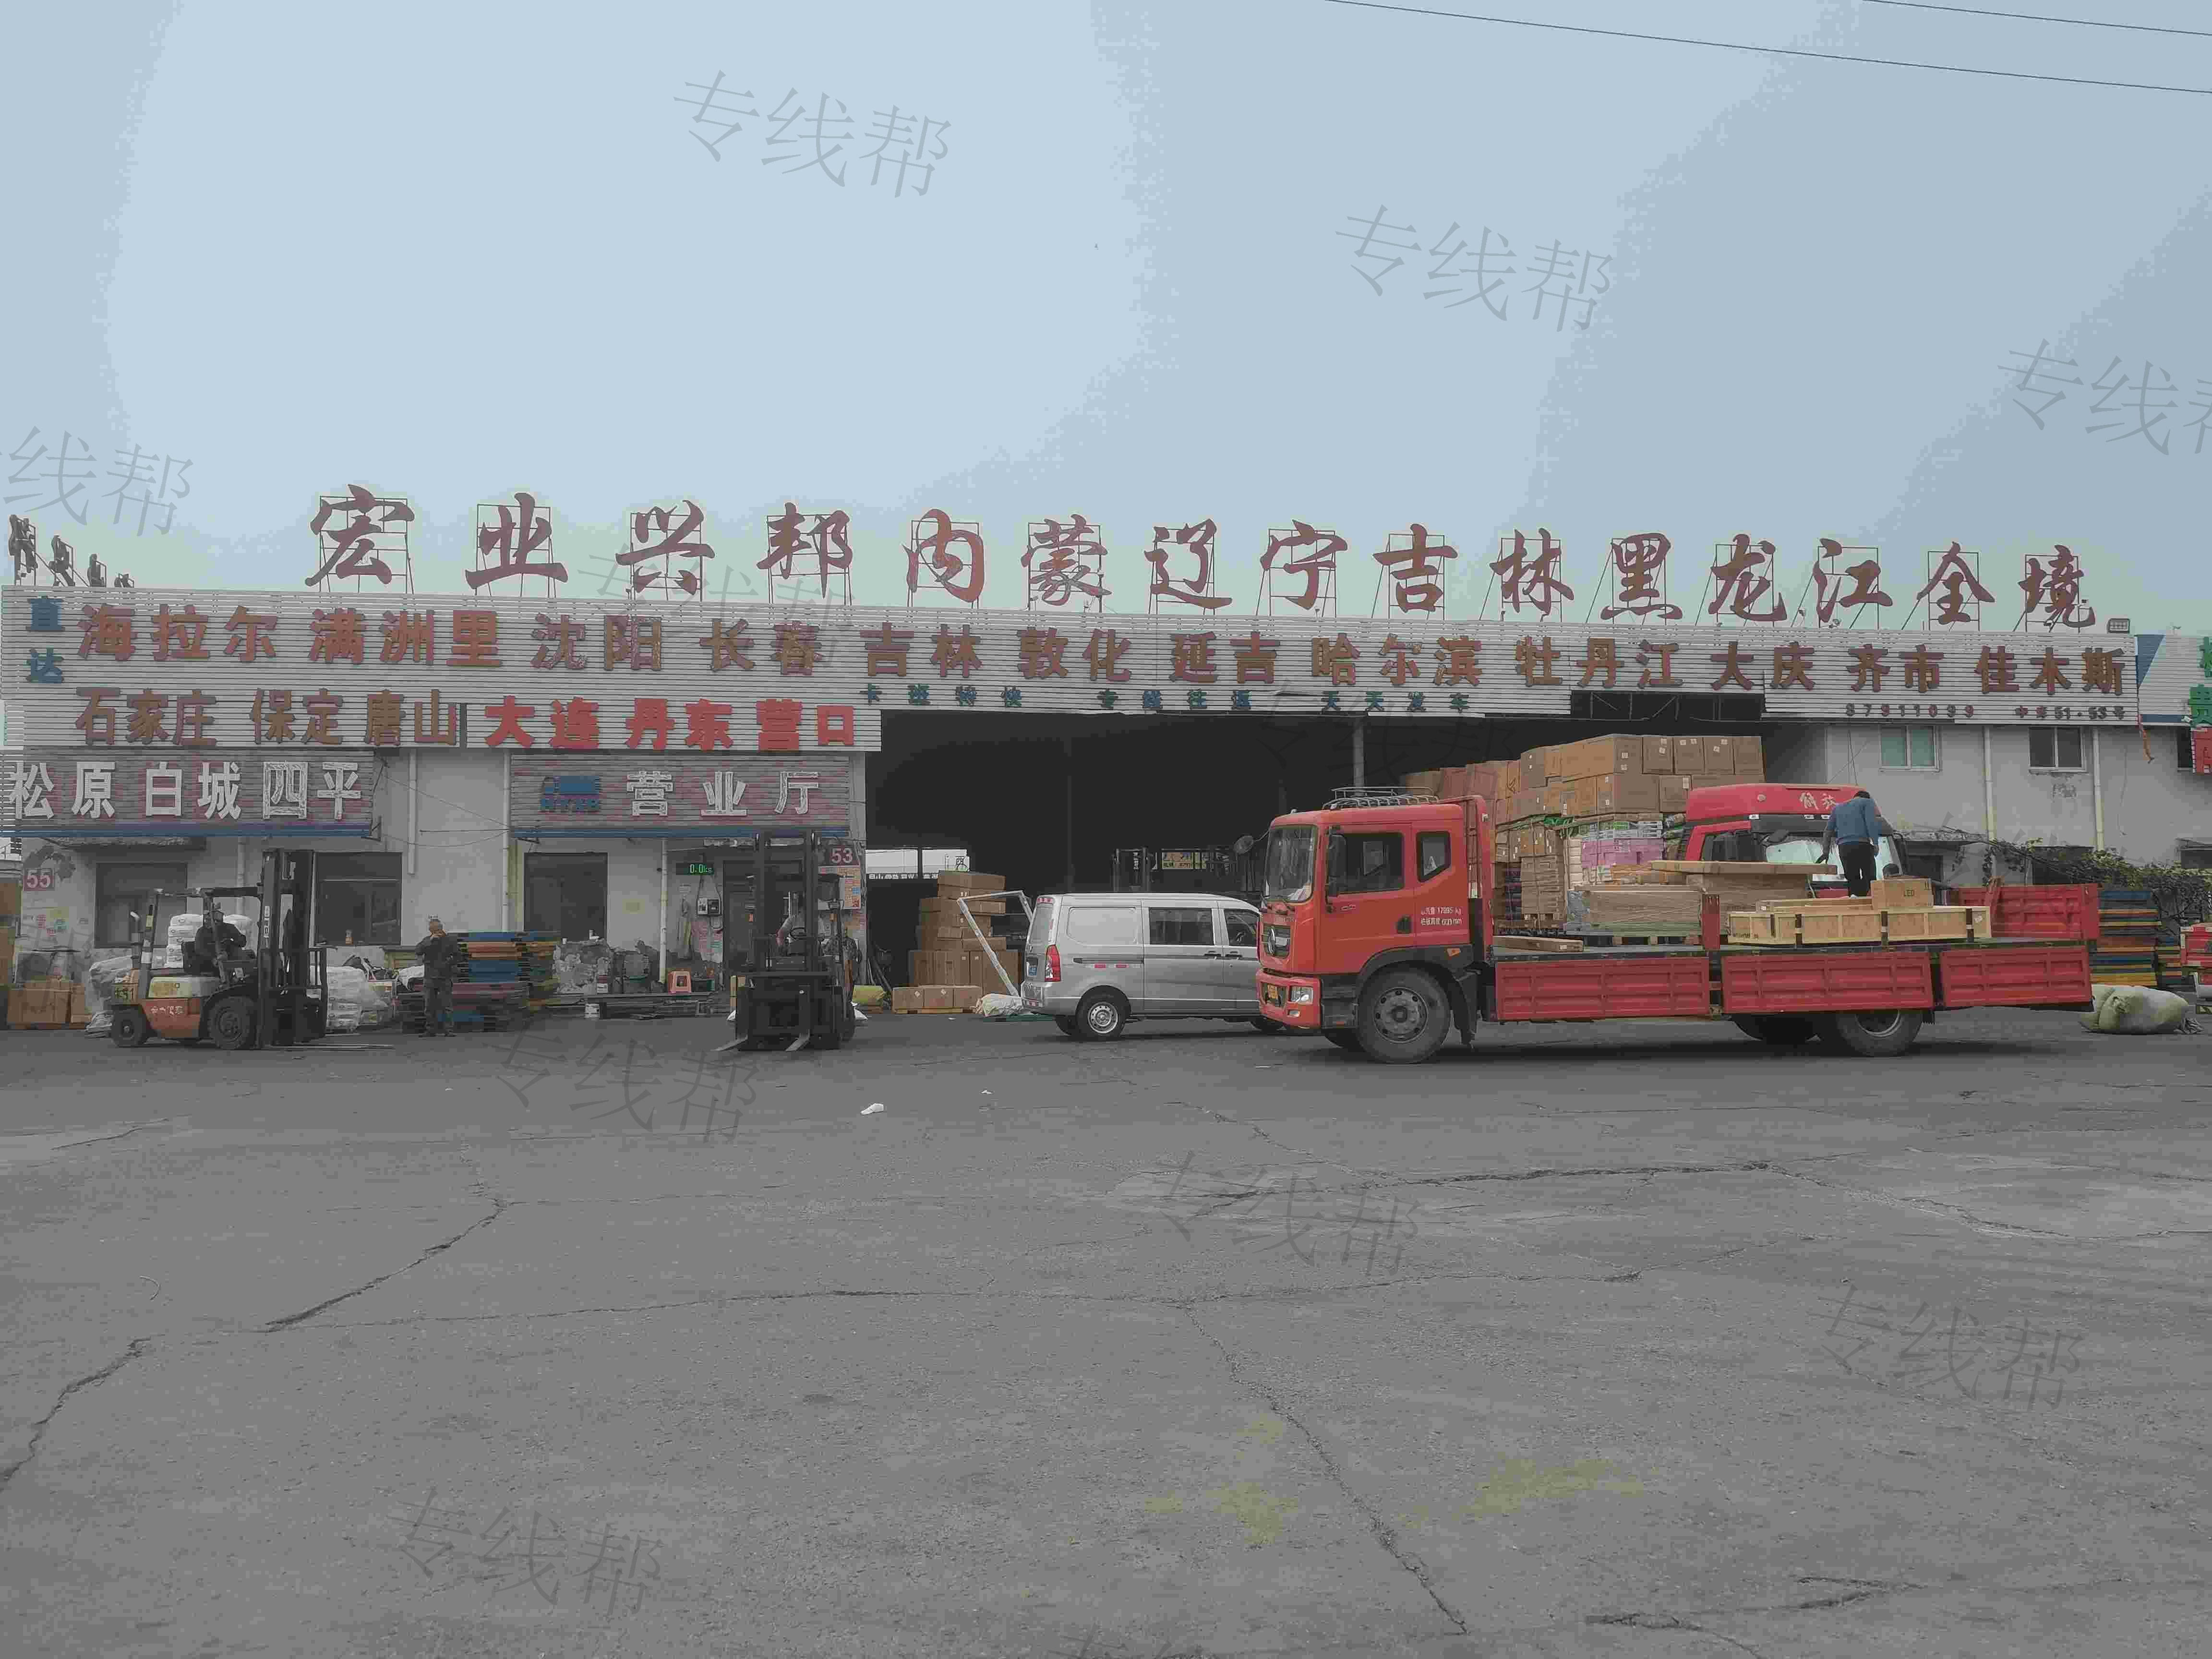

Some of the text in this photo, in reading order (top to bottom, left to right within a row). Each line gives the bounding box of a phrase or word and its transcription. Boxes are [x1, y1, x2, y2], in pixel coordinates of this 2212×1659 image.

[26, 596, 64, 684] 直达
[77, 604, 2125, 696] 海拉尔 满洲里 沈阳 长春 吉林 敦化 延吉 哈尔滨 牡丹江 大庆 齐市 佳木斯
[75, 686, 457, 746] 石家庄 保定 唐山
[484, 695, 855, 752] 大连 丹东 营口
[1320, 690, 1470, 714] 天天发车
[8, 760, 362, 820] 松原 白城 四平
[626, 770, 820, 817] 营业厅
[27, 869, 50, 888] 55
[831, 848, 853, 864] 53
